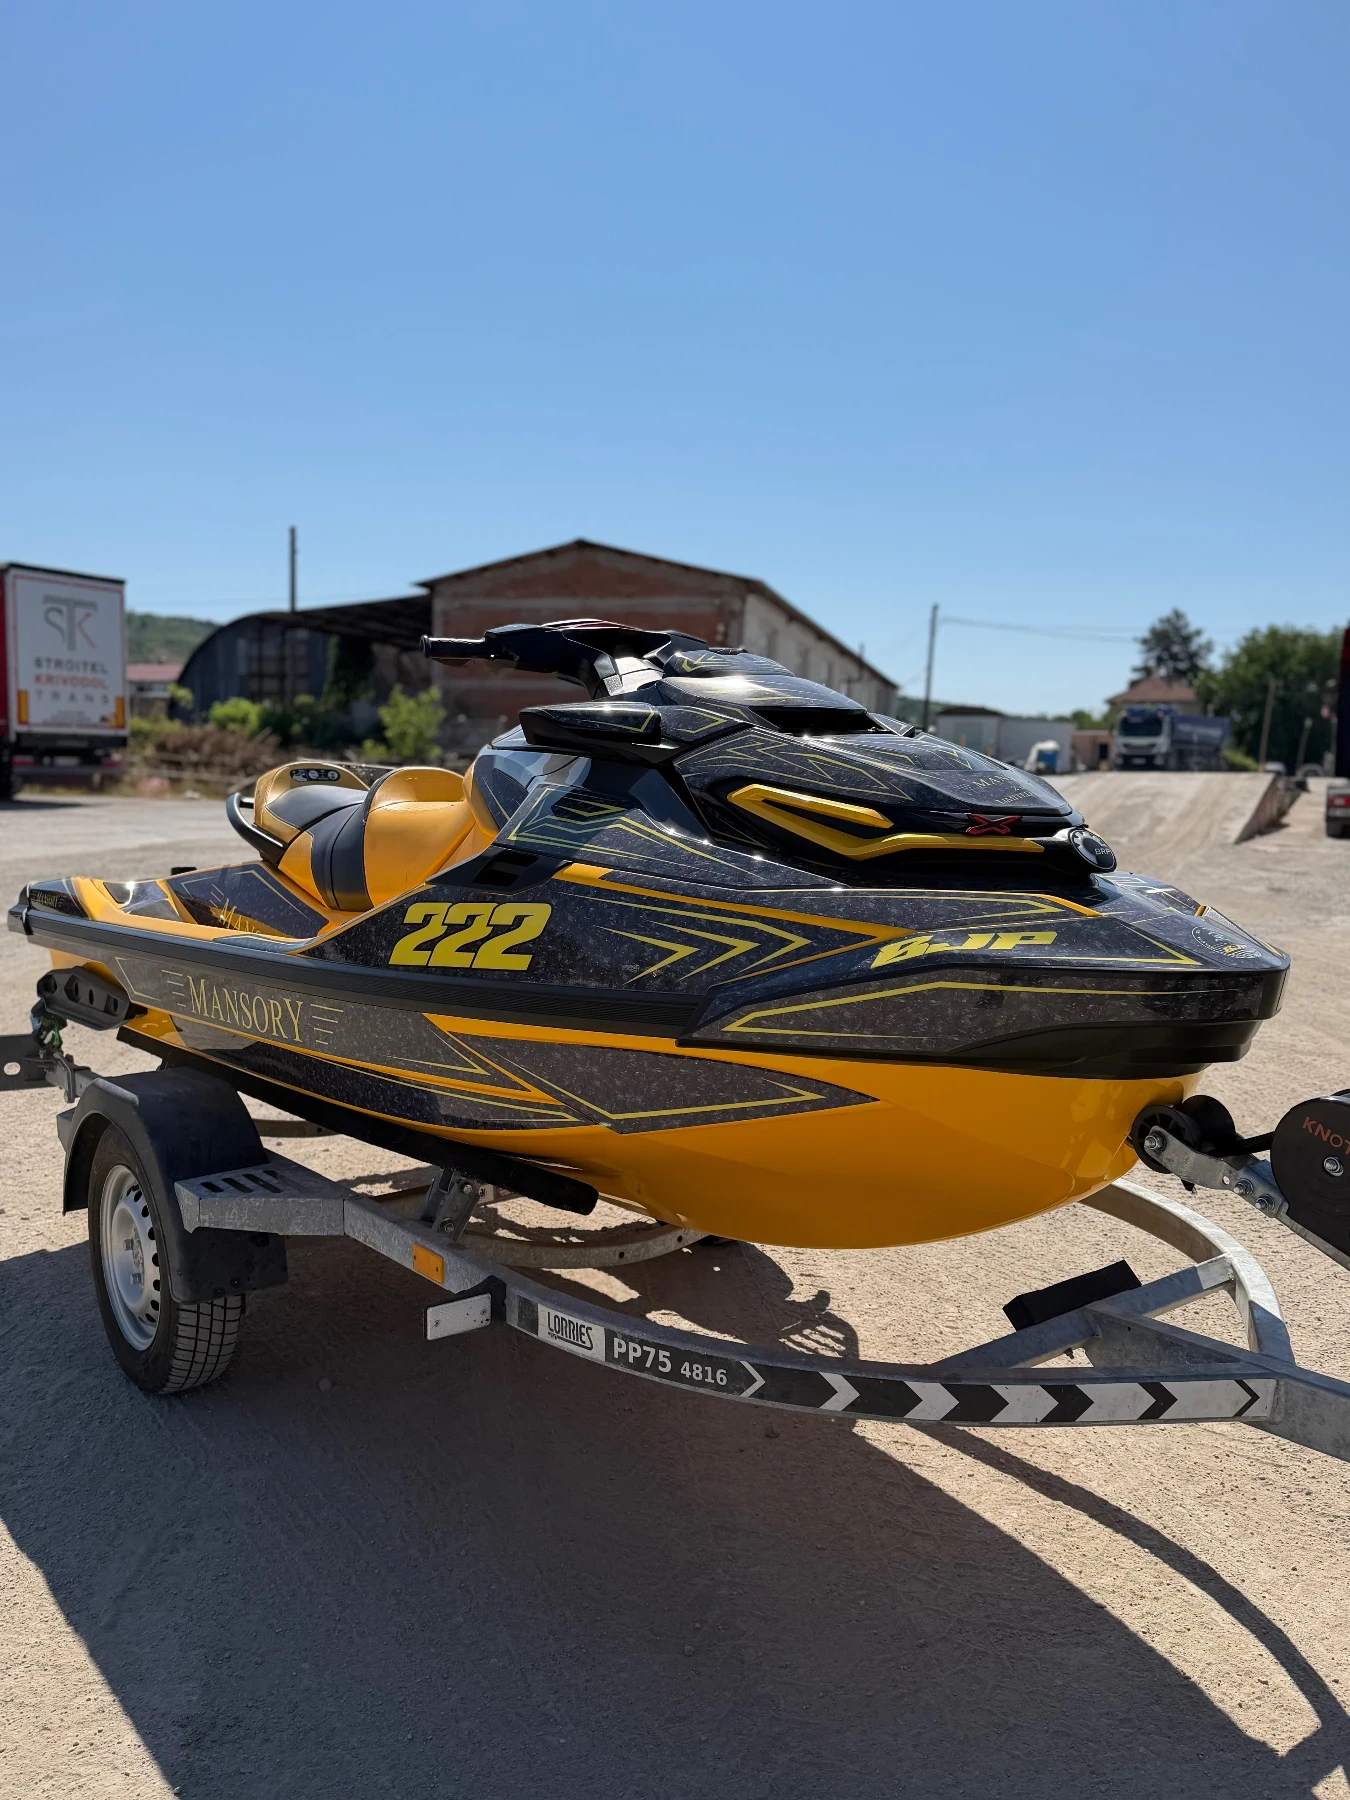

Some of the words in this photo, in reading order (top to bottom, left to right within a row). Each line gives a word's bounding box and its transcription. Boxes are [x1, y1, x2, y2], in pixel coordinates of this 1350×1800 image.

[34, 657, 109, 674] STROITEL
[34, 673, 109, 690] KRIVODOL
[35, 688, 110, 706] TRANS
[388, 902, 552, 971] 222
[187, 975, 303, 1042] MANSORY
[547, 1311, 593, 1350] LORRIES
[613, 1337, 672, 1373] PP75
[680, 1361, 728, 1386] 4816
